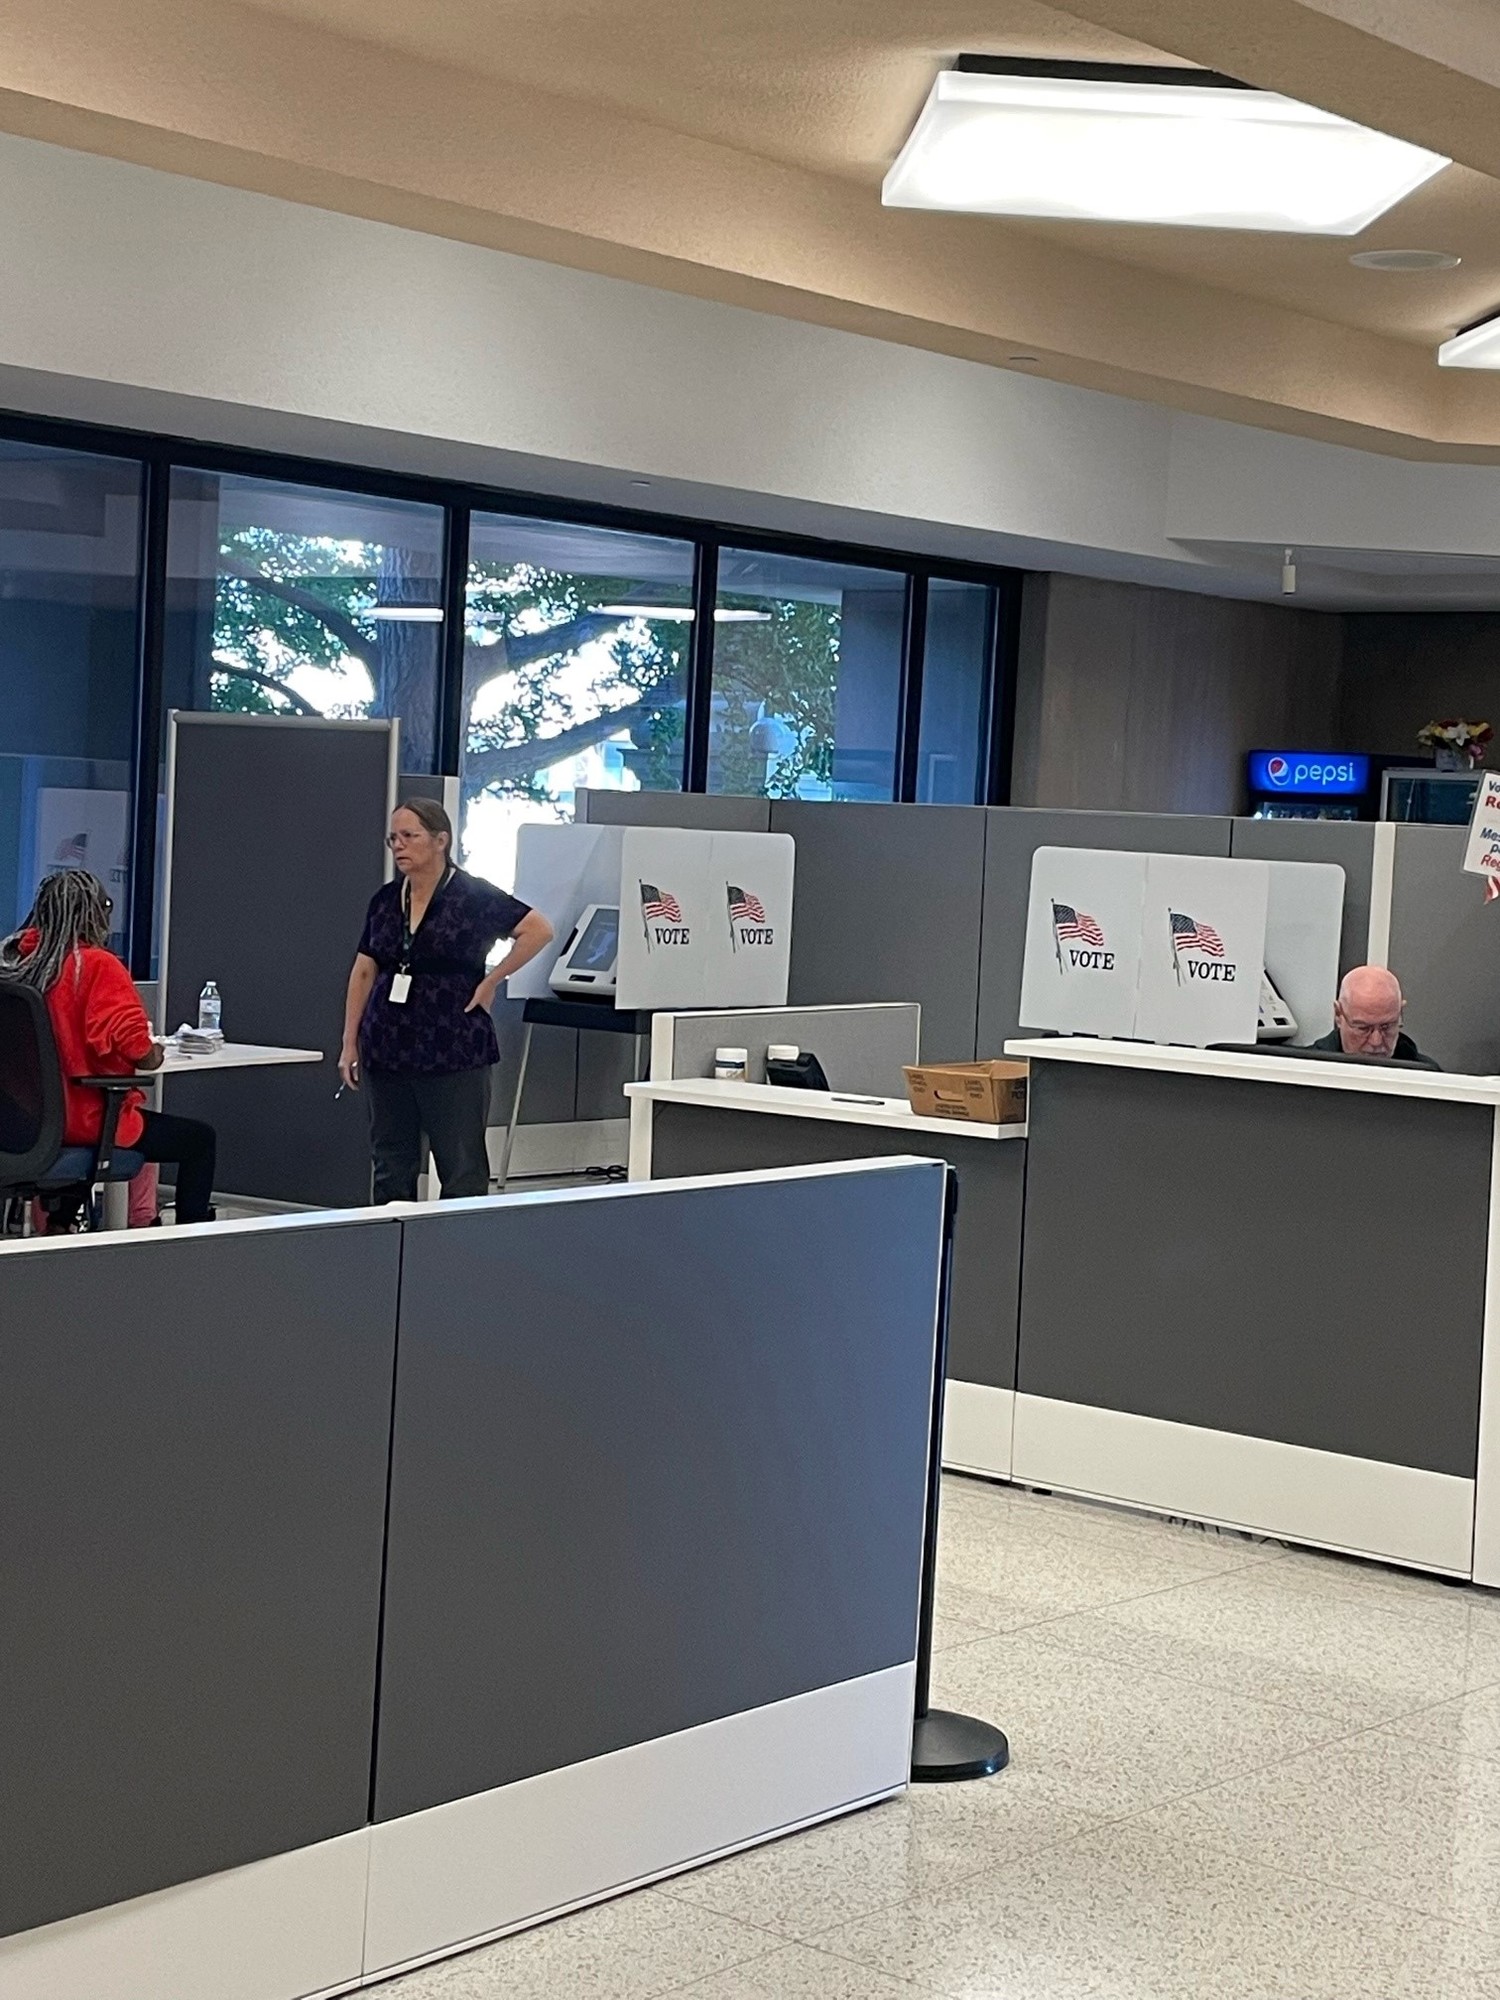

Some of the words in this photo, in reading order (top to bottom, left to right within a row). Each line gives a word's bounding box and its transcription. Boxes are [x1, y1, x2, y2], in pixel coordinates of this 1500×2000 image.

[1294, 762, 1356, 785] pepsi
[654, 928, 690, 945] VOTE
[740, 928, 774, 945] VOTE
[1069, 949, 1115, 971] VOTE
[1187, 960, 1237, 982] VOTE
